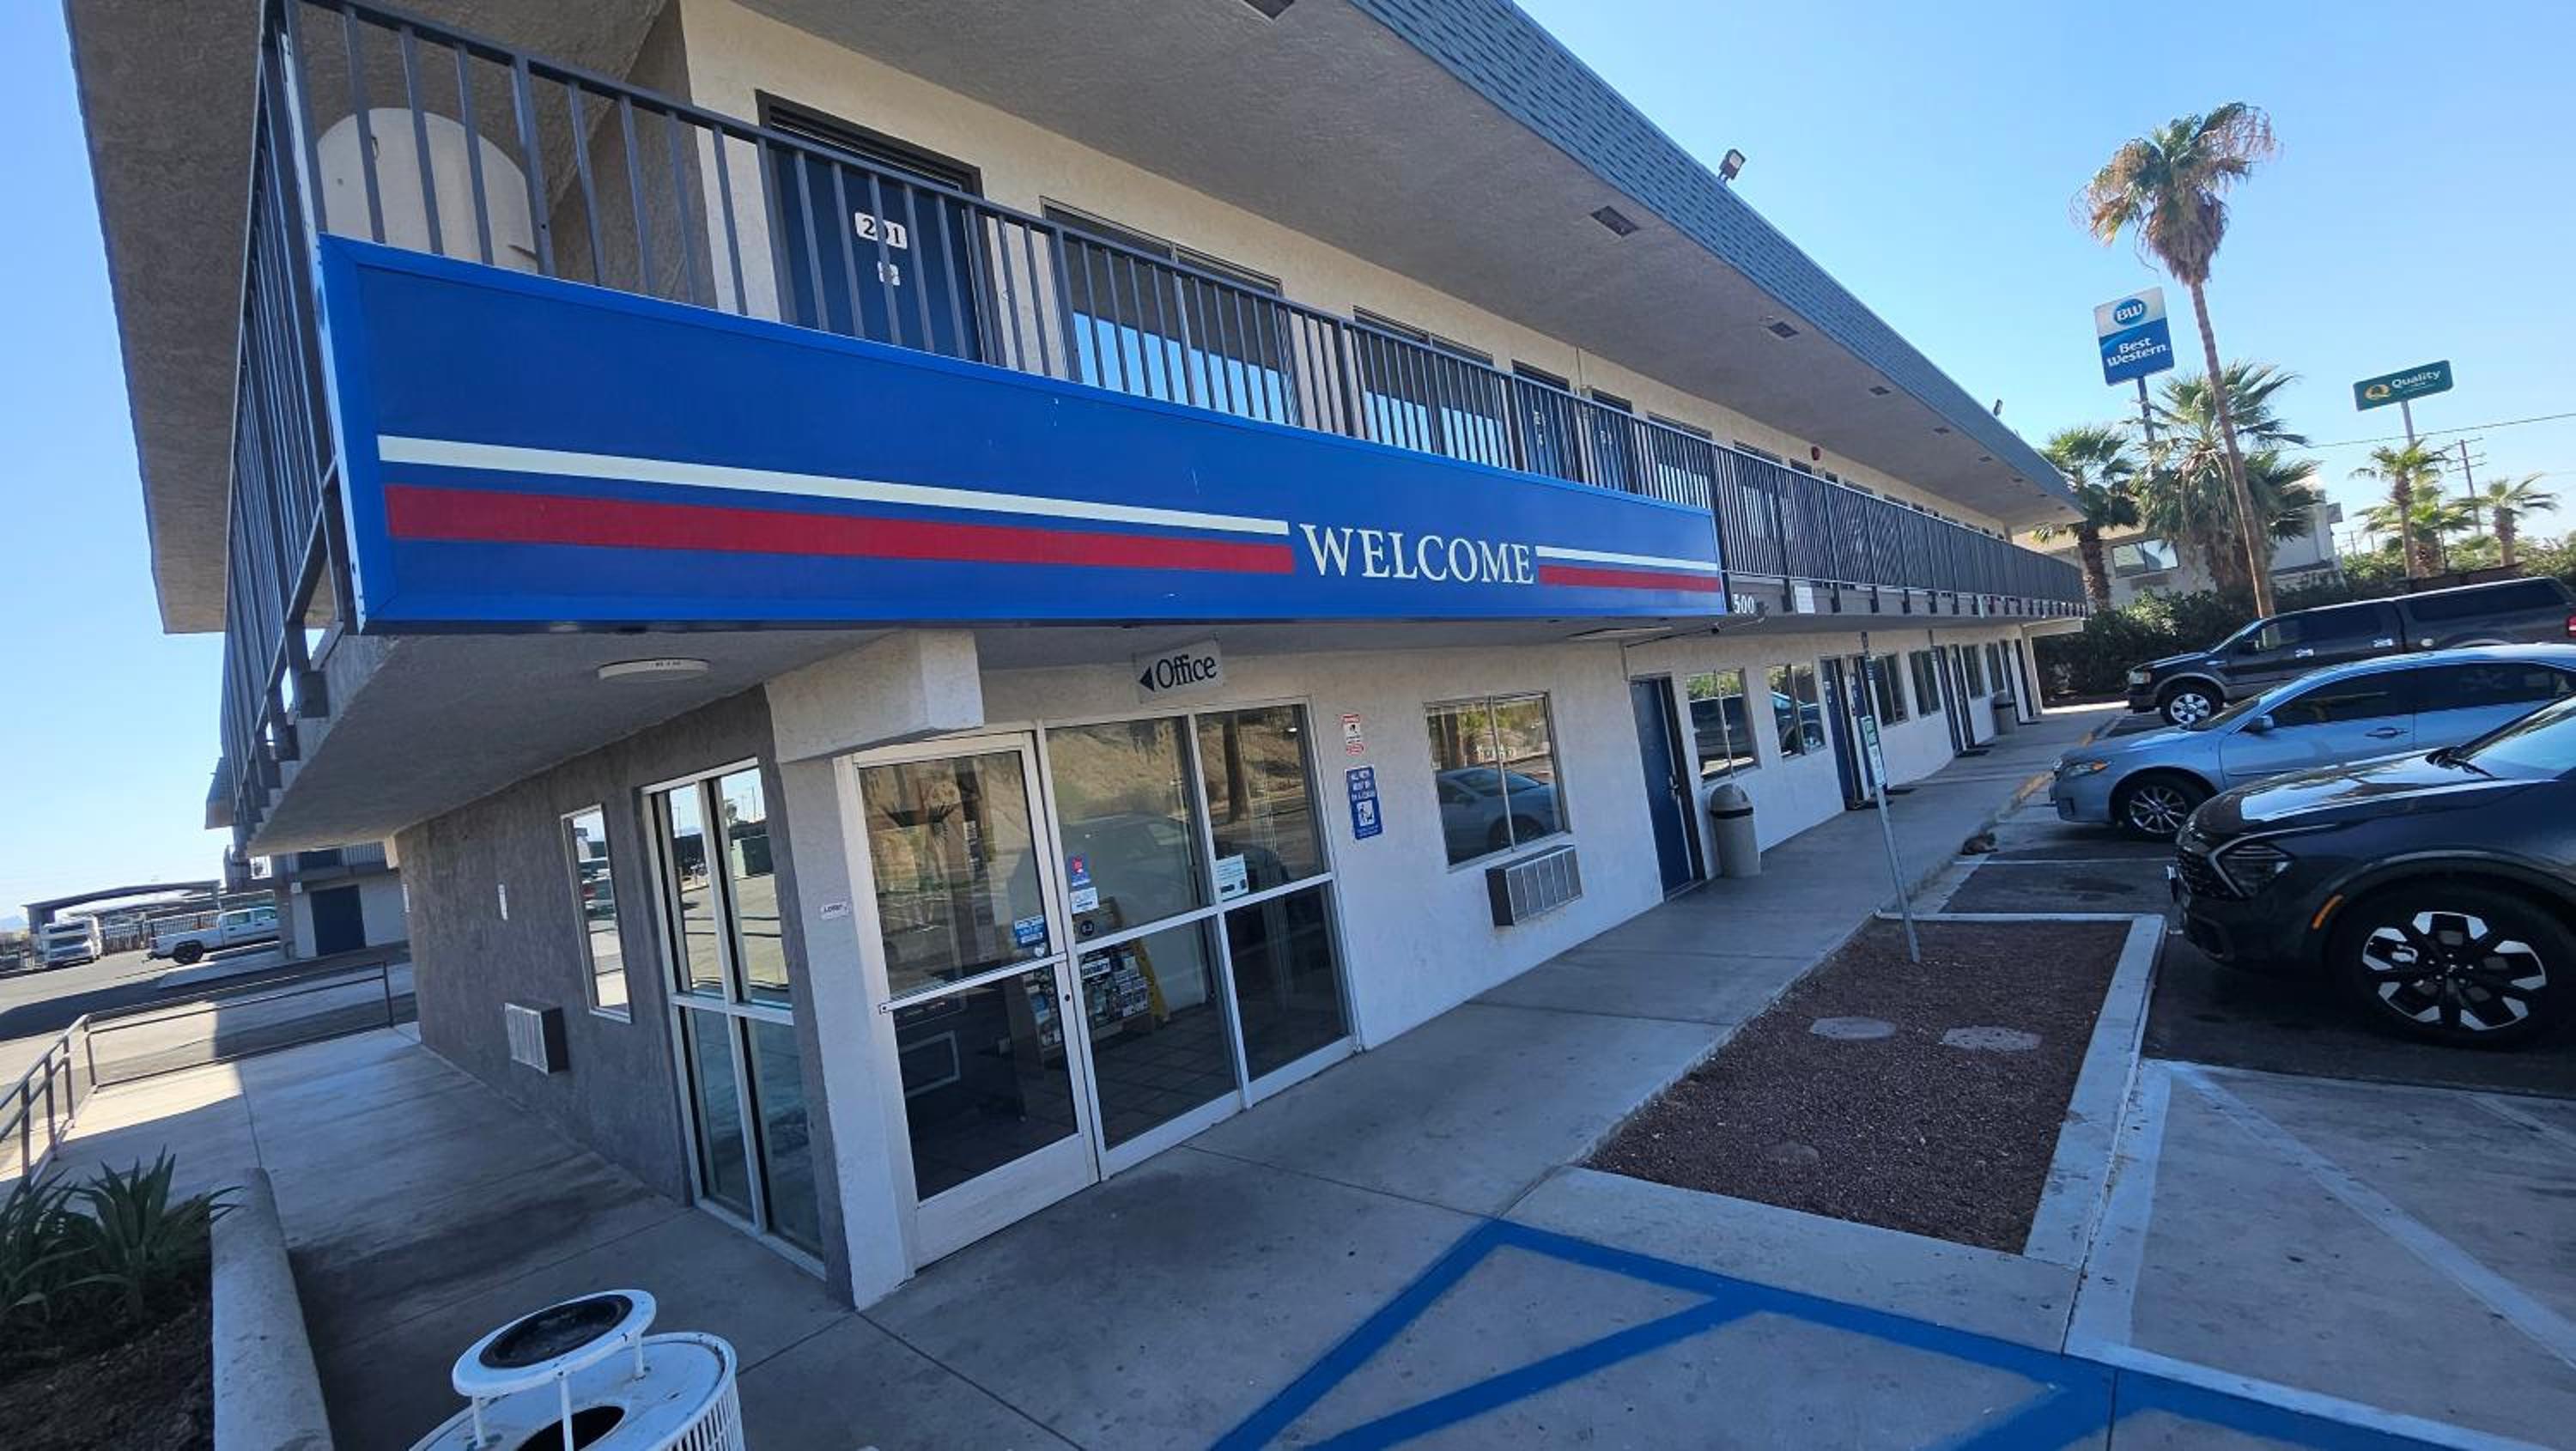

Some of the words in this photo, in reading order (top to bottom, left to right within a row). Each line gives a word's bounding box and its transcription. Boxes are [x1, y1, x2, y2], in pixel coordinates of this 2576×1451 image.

[2116, 303, 2143, 322] BW
[2106, 343, 2166, 367] Western
[2118, 337, 2153, 355] Best
[2391, 370, 2440, 390] Quality
[1298, 523, 1534, 585] WELCOME
[1733, 594, 1755, 614] 500
[1156, 654, 1217, 689] Office
